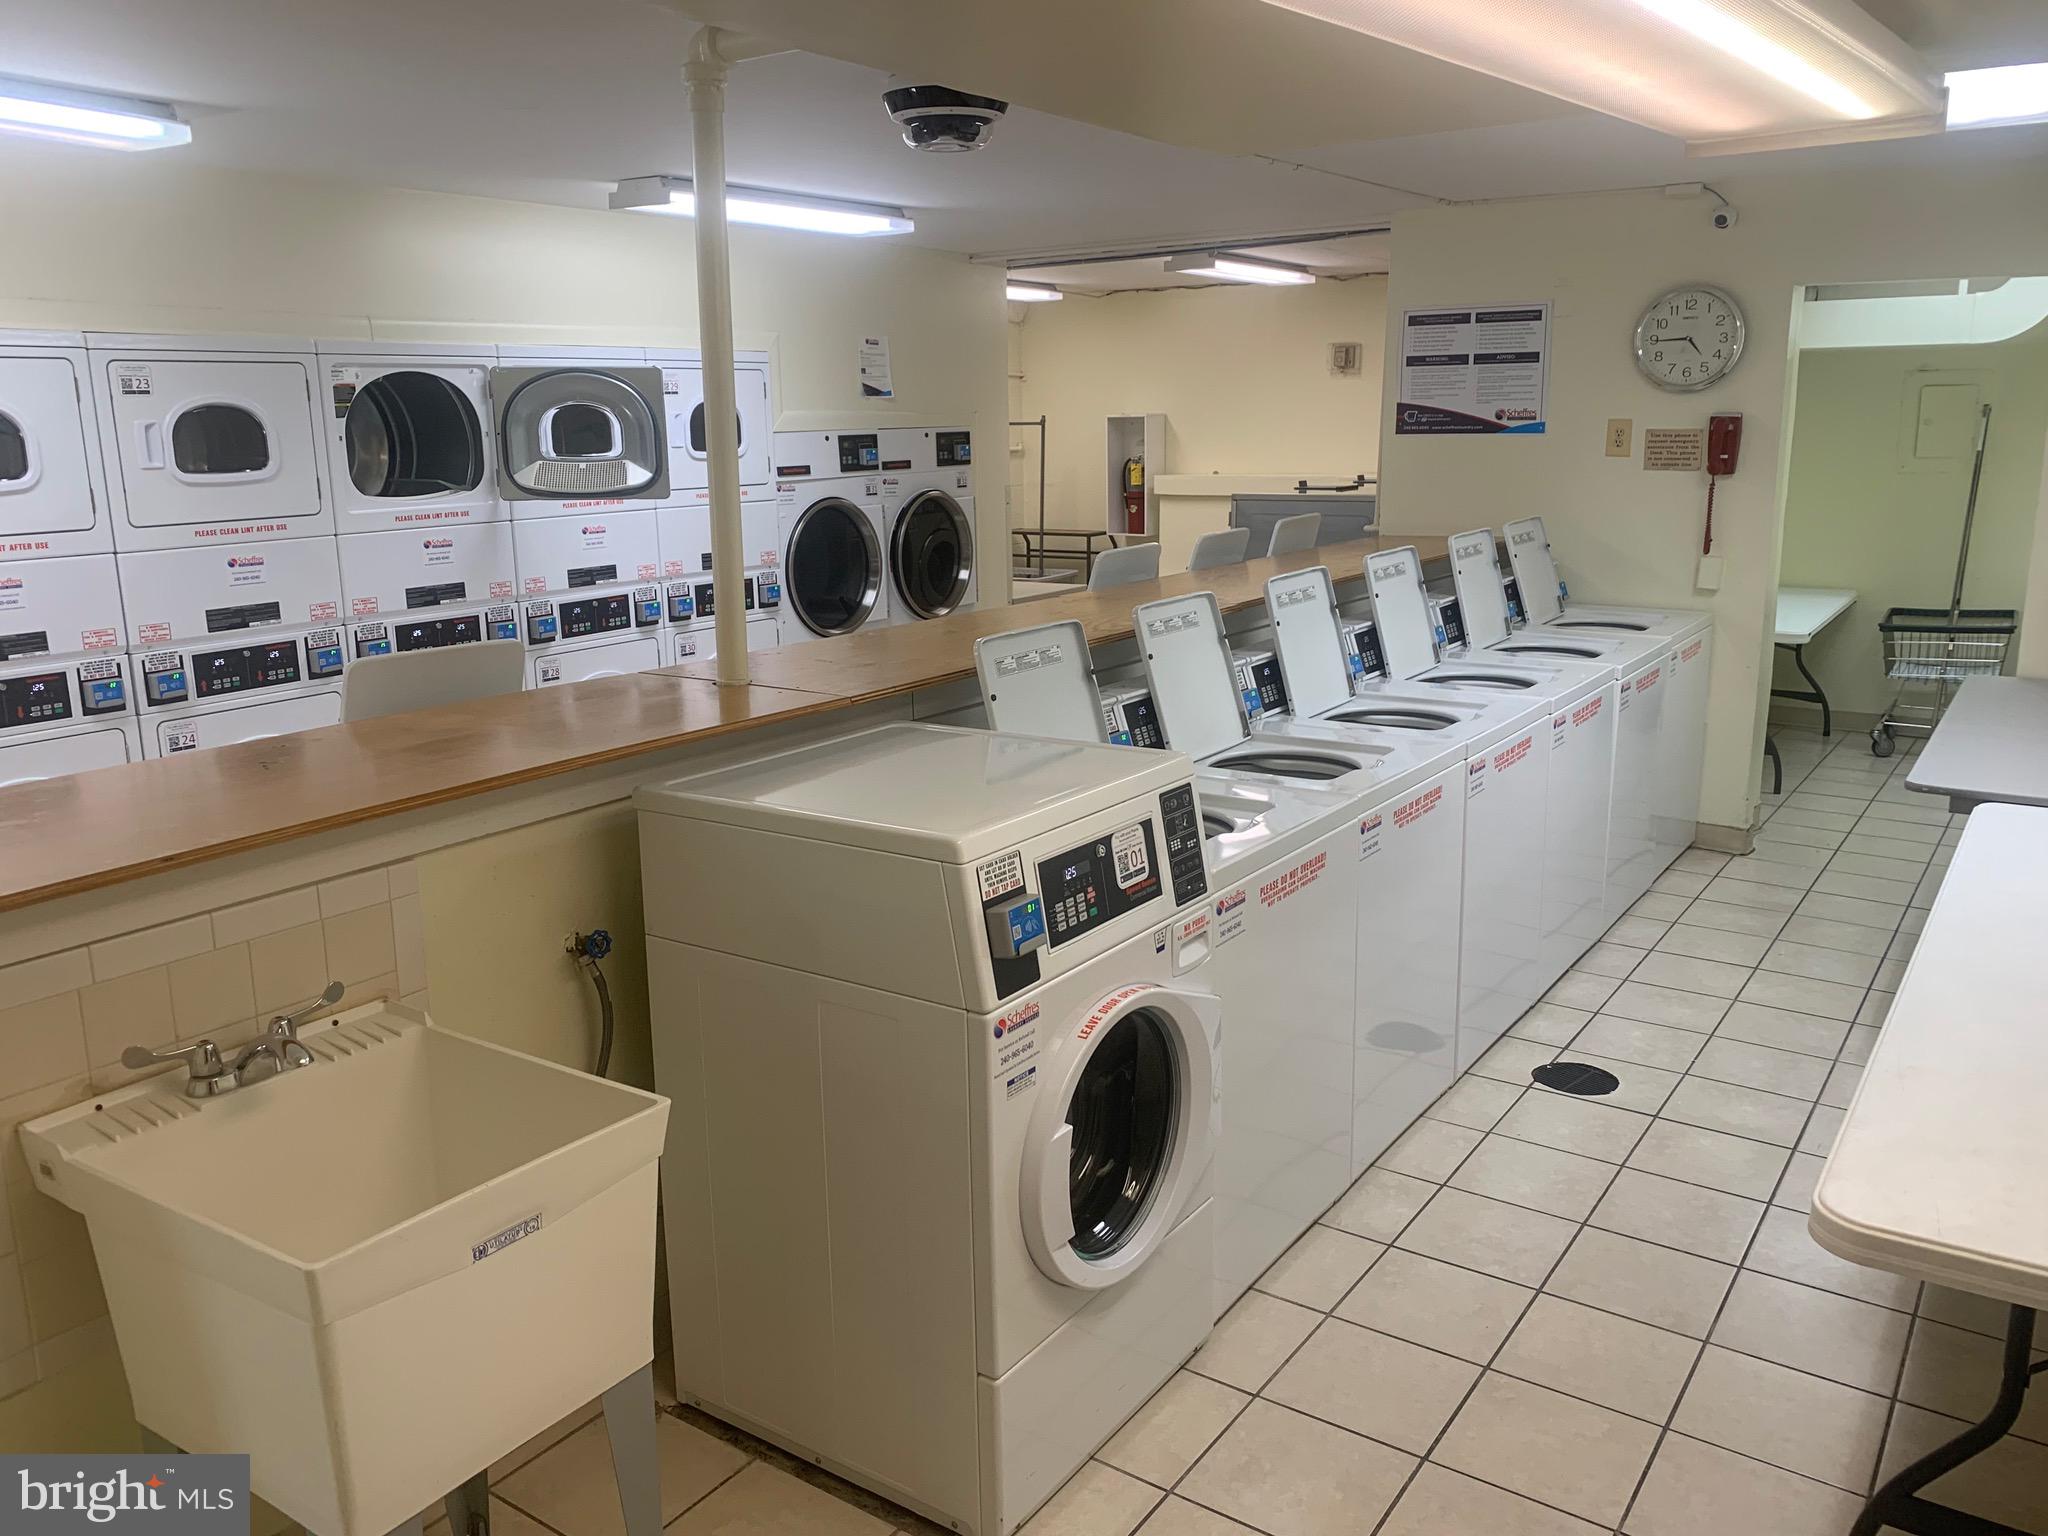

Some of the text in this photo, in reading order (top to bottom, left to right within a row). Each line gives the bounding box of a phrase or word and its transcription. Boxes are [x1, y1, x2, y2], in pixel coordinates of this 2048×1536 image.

[1685, 299, 1698, 310] 12
[1707, 302, 1711, 313] 1
[1670, 305, 1679, 316] 11
[1656, 318, 1668, 330] 10
[1715, 314, 1726, 326] 2
[1649, 334, 1659, 345] 9
[1719, 332, 1728, 343] 3
[1654, 351, 1663, 362] 8
[1712, 349, 1721, 360] 4
[1667, 363, 1677, 375] 7
[1682, 367, 1692, 378] 6
[1699, 362, 1709, 373] 5
[135, 378, 150, 389] 23
[394, 514, 413, 522] PLEASE
[432, 512, 442, 520] LINT
[194, 529, 217, 538] PLEASE
[220, 527, 239, 536] CLEAN
[240, 526, 254, 534] LINT
[256, 524, 274, 532] AFTER
[9, 542, 33, 552] AFTER
[34, 542, 49, 550] USE
[550, 667, 560, 676] 28
[182, 734, 196, 745] 24
[1130, 847, 1145, 868] 01
[1260, 878, 1280, 898] PLEASE
[1280, 874, 1288, 886] DO
[1289, 866, 1299, 881] NOT
[984, 878, 1021, 899] DO NOT TAP CARD
[1027, 903, 1035, 912] 01
[1007, 1002, 1040, 1025] Scheffres
[1077, 988, 1139, 1040] LEAVE DOOR OPEN
